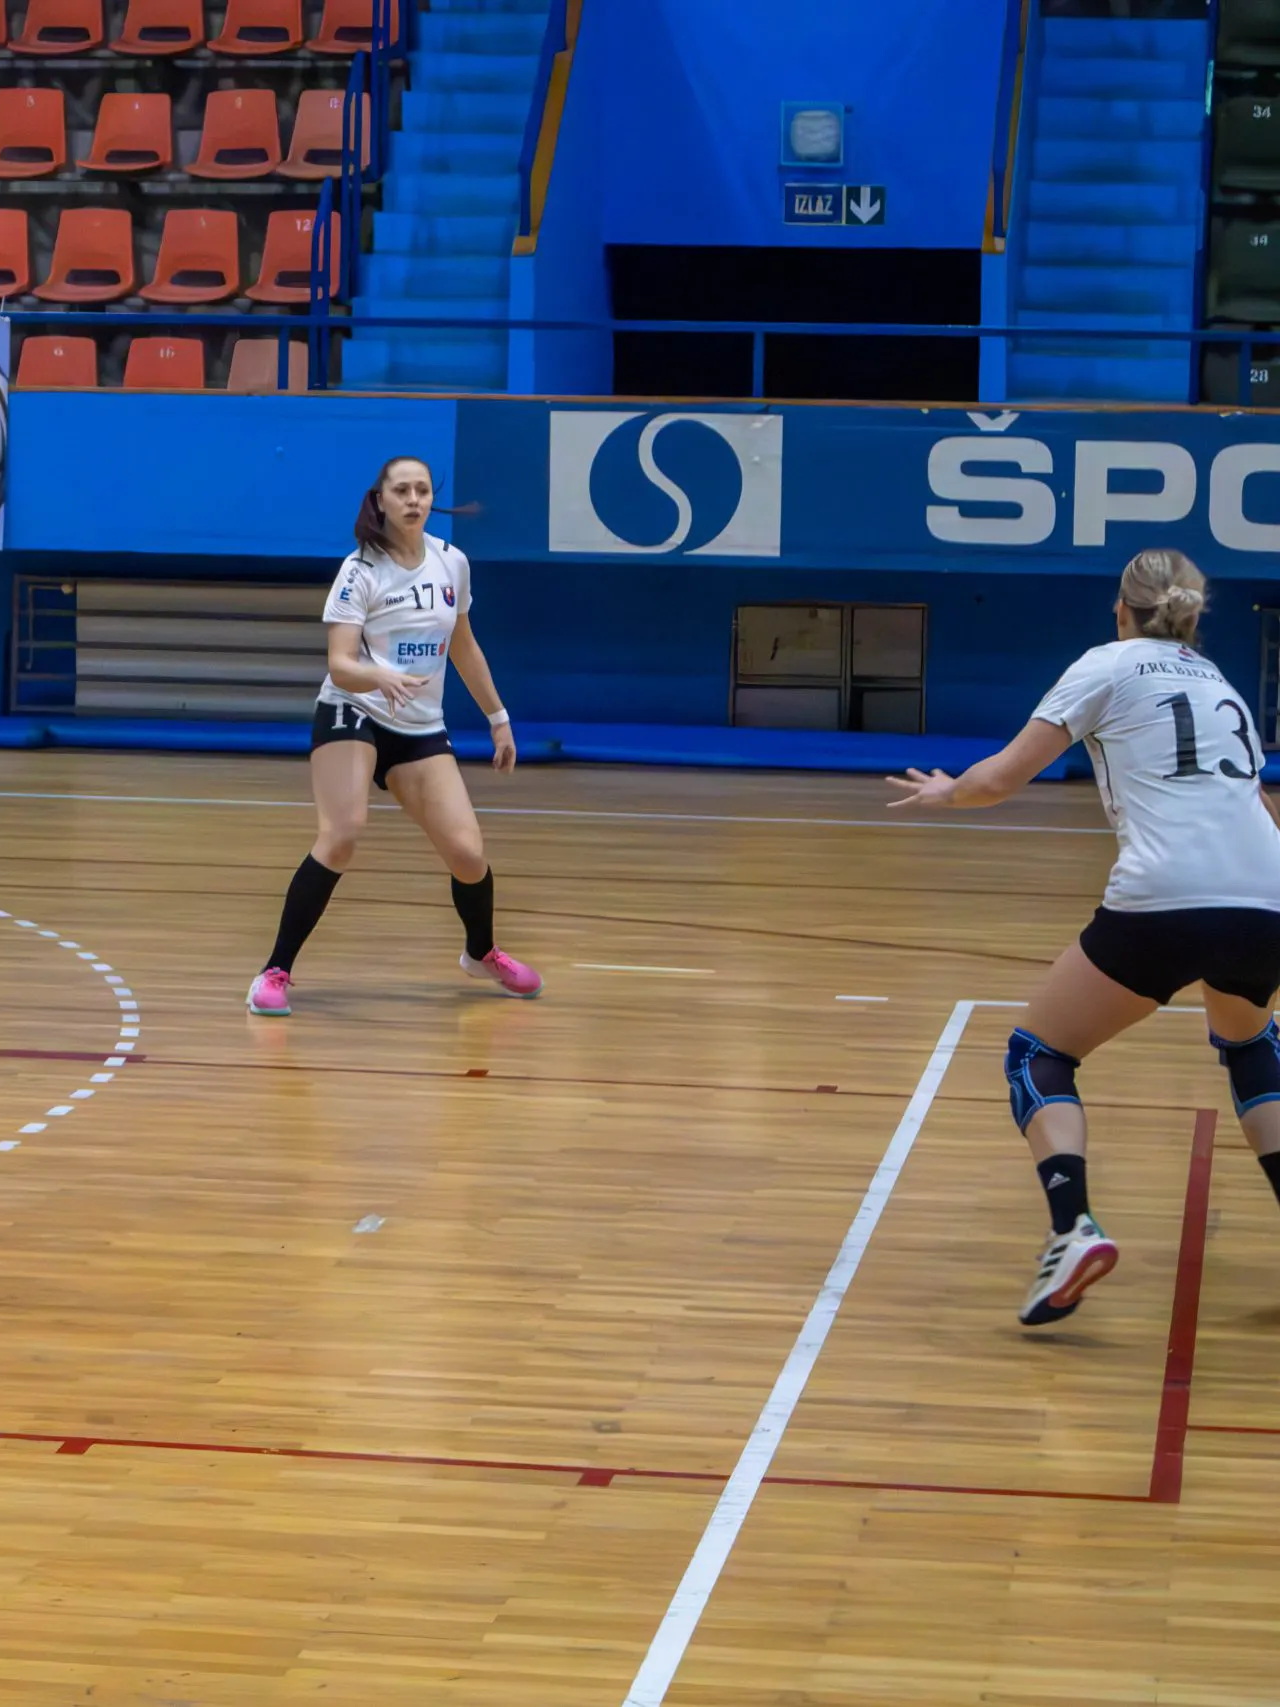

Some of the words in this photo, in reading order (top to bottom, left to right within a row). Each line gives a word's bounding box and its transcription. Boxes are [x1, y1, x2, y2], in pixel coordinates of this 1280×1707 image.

[1253, 103, 1271, 116] 34
[795, 194, 833, 215] IZLAZ
[296, 217, 312, 229] 12
[385, 596, 405, 606] JAKO
[410, 583, 434, 610] 17
[398, 643, 437, 656] ERSTE
[331, 698, 368, 730] 17
[1156, 691, 1256, 780] 13
